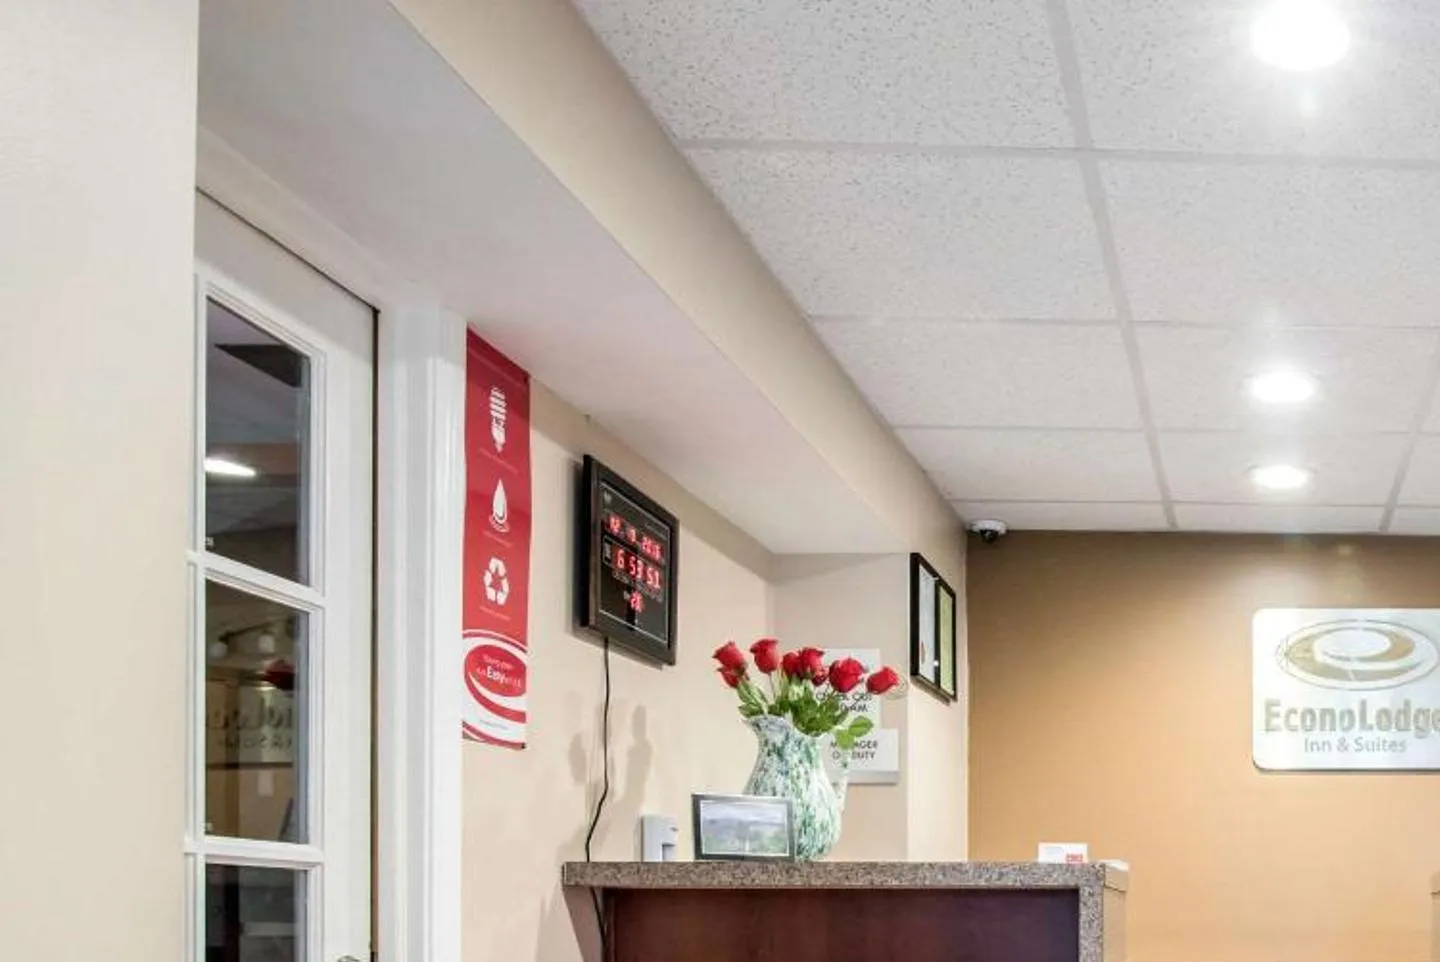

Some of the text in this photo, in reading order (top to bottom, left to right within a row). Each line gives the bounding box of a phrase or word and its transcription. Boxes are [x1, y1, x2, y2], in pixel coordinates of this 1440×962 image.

[1304, 736, 1408, 753] Inn & Suites
